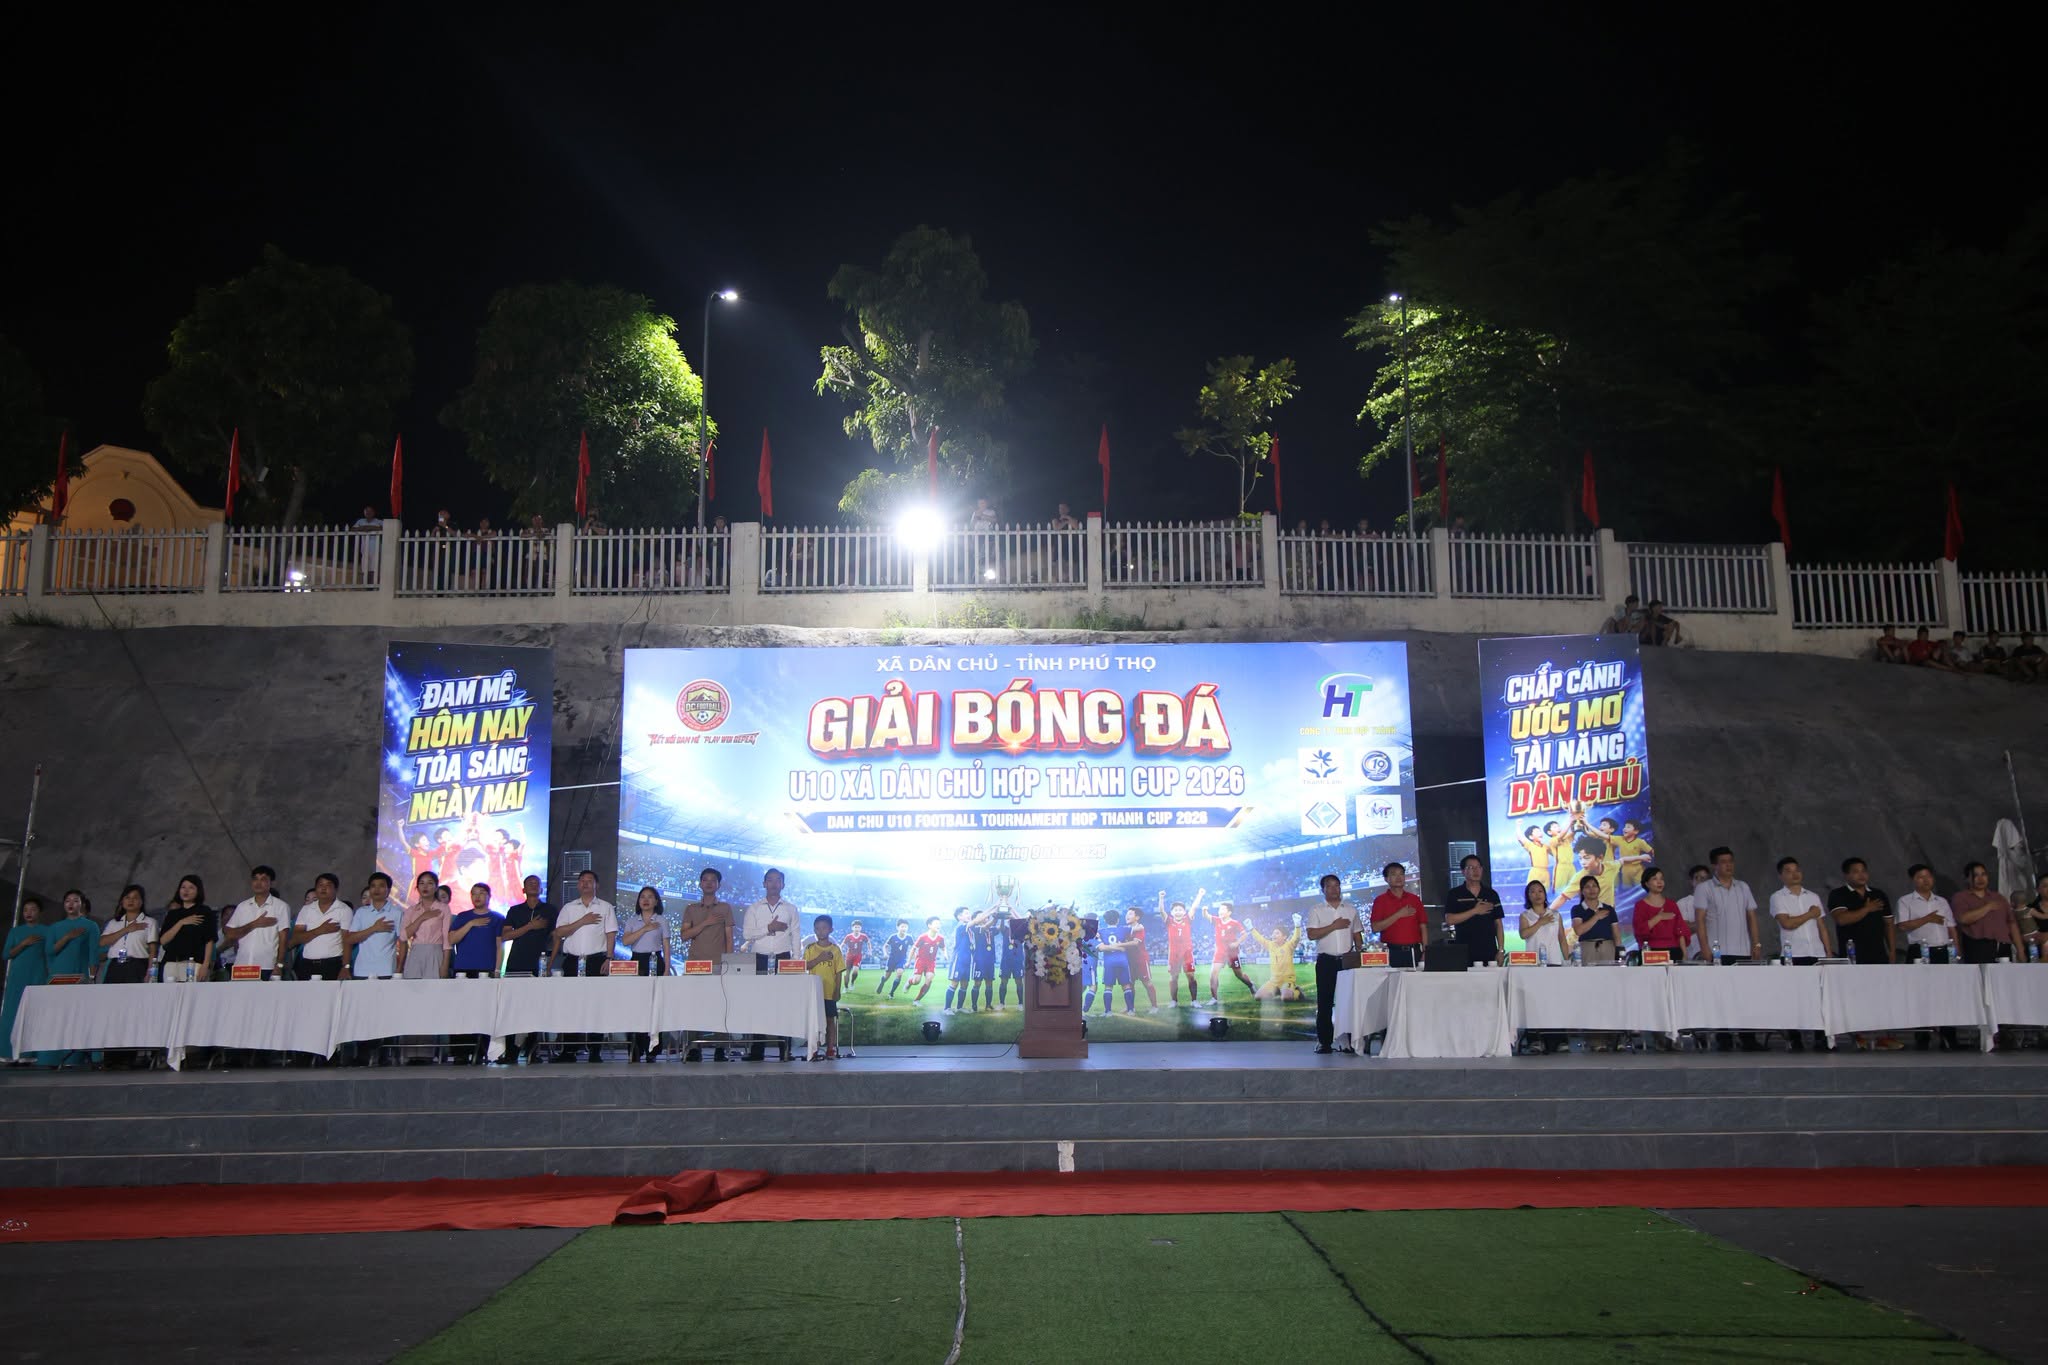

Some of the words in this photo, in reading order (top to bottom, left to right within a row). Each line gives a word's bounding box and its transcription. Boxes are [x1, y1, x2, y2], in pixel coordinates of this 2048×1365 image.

[876, 656, 904, 673] XÃ
[908, 655, 951, 672] DÂN
[956, 653, 999, 671] CHỦ
[1016, 652, 1063, 671] TỈNH
[1071, 653, 1110, 671] PHÚ
[1115, 655, 1157, 673] THỌ
[1566, 661, 1623, 695] CÁNH
[421, 677, 478, 712] ĐAM
[479, 671, 515, 703] MÊ
[408, 708, 477, 752] HÔM
[479, 705, 536, 744] NAY
[808, 679, 941, 758] GIẢI
[952, 678, 1126, 753] BÓNG
[1136, 682, 1232, 754] ĐÁ
[1511, 699, 1571, 740] ƯỚC
[1576, 690, 1626, 731] MƠ
[415, 747, 461, 787] TỎA
[467, 742, 528, 780] SÁNG
[1514, 740, 1551, 776] TÀI
[1557, 732, 1626, 769] NĂNG
[408, 783, 481, 824] NGÀY
[481, 780, 528, 814] MAI
[789, 769, 835, 802] U10
[840, 764, 876, 801] XÃ
[880, 763, 932, 801] DÂN
[937, 759, 986, 800] CHỦ
[991, 764, 1041, 804] HỢP
[1046, 761, 1126, 799] THÀNH
[1131, 767, 1179, 798] CUP
[1185, 765, 1246, 797] 2026
[1508, 774, 1575, 817] DÂN
[1578, 757, 1643, 804] CHỦ
[827, 815, 855, 829] DAN
[857, 815, 884, 829] CHU
[887, 814, 912, 828] U10
[915, 813, 978, 828] FOOTBALL
[981, 812, 1068, 827] TOURNAMENT
[1071, 812, 1098, 826] HOP
[1101, 811, 1144, 826] THANH
[1147, 811, 1173, 825] CUP
